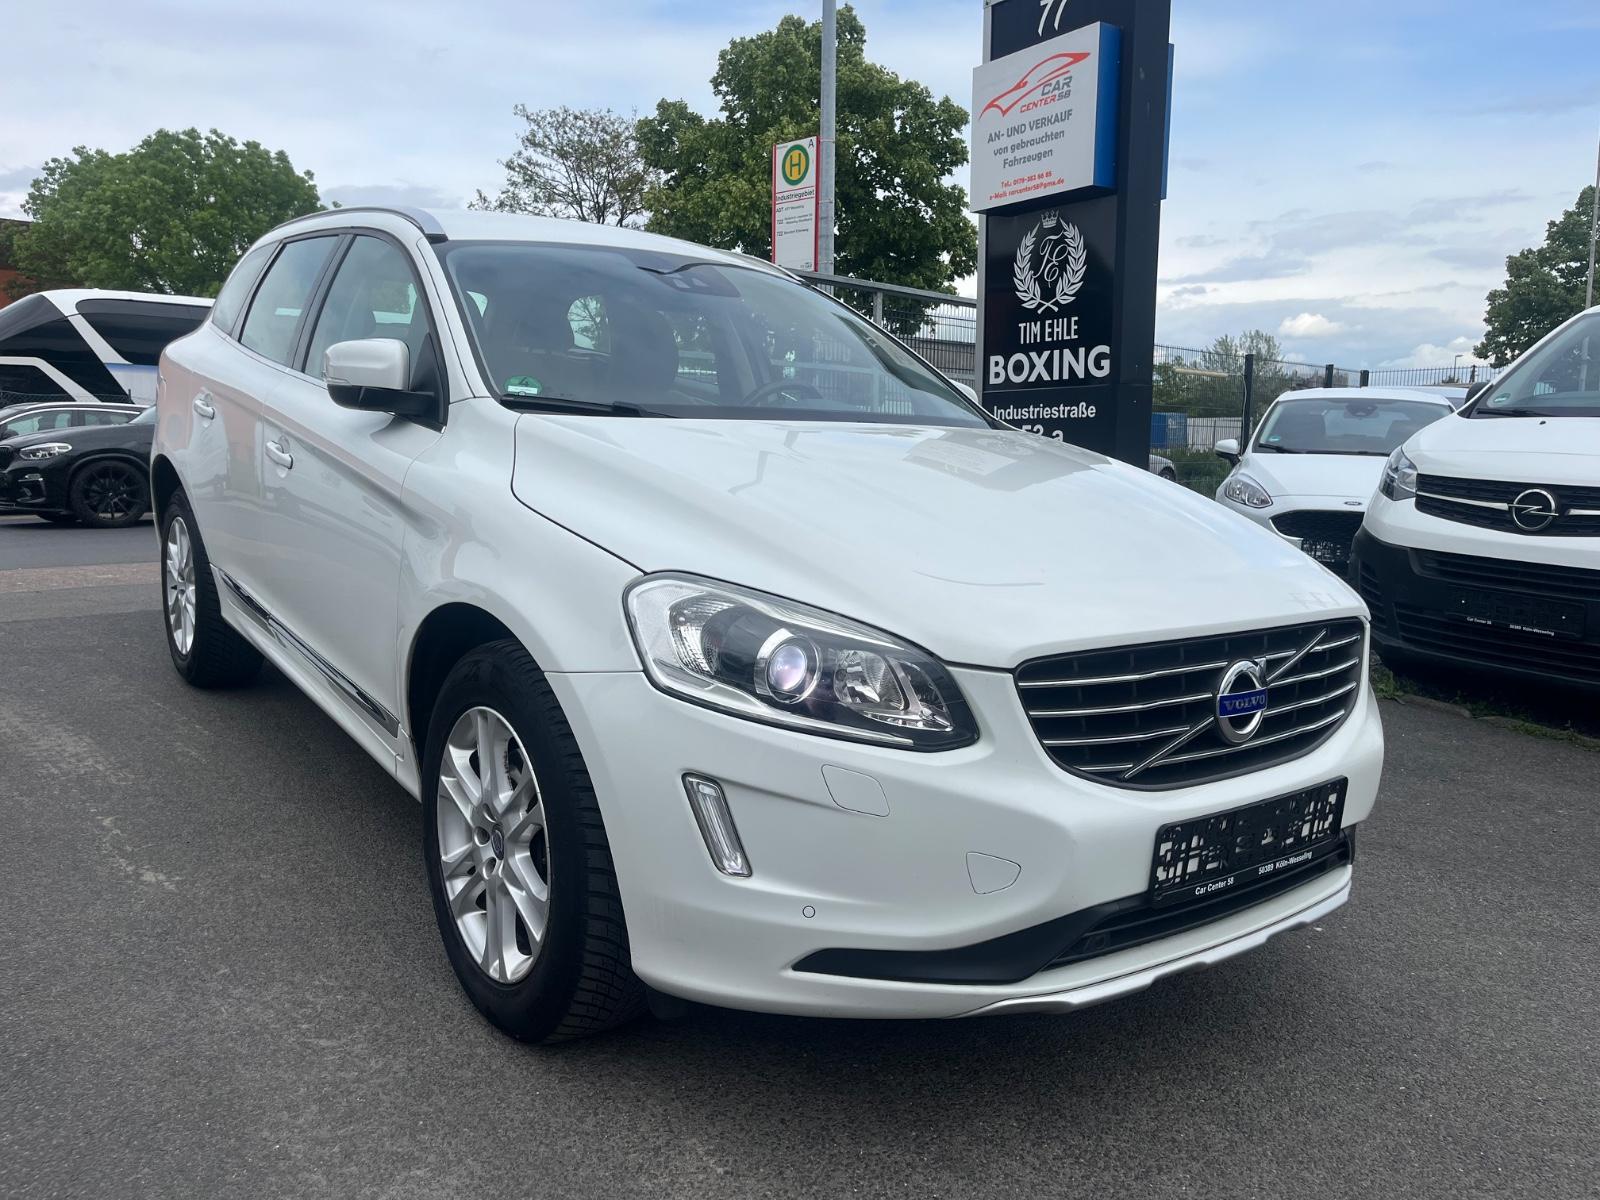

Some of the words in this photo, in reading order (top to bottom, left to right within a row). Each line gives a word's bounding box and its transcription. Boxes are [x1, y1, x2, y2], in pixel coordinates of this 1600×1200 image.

[1041, 76, 1073, 96] CAR
[987, 130, 1005, 143] AN-
[1006, 123, 1027, 137] UND
[1029, 109, 1073, 131] VERKAUF
[808, 138, 815, 149] A
[993, 145, 1009, 156] von
[1010, 130, 1065, 153] gebrauchten
[789, 152, 802, 177] H
[1003, 149, 1053, 168] Fahrzeugen
[776, 189, 815, 201] Industriegebiet
[1018, 320, 1041, 345] TIM
[1045, 316, 1079, 342] EHLE
[989, 344, 1111, 385] BOXING
[993, 401, 1096, 420] Industriestraße
[1223, 694, 1266, 711] VOLVO
[1195, 886, 1207, 896] Car
[1207, 879, 1227, 892] Center
[1227, 876, 1234, 886] 58
[1275, 851, 1313, 869] Köln-Wesseling
